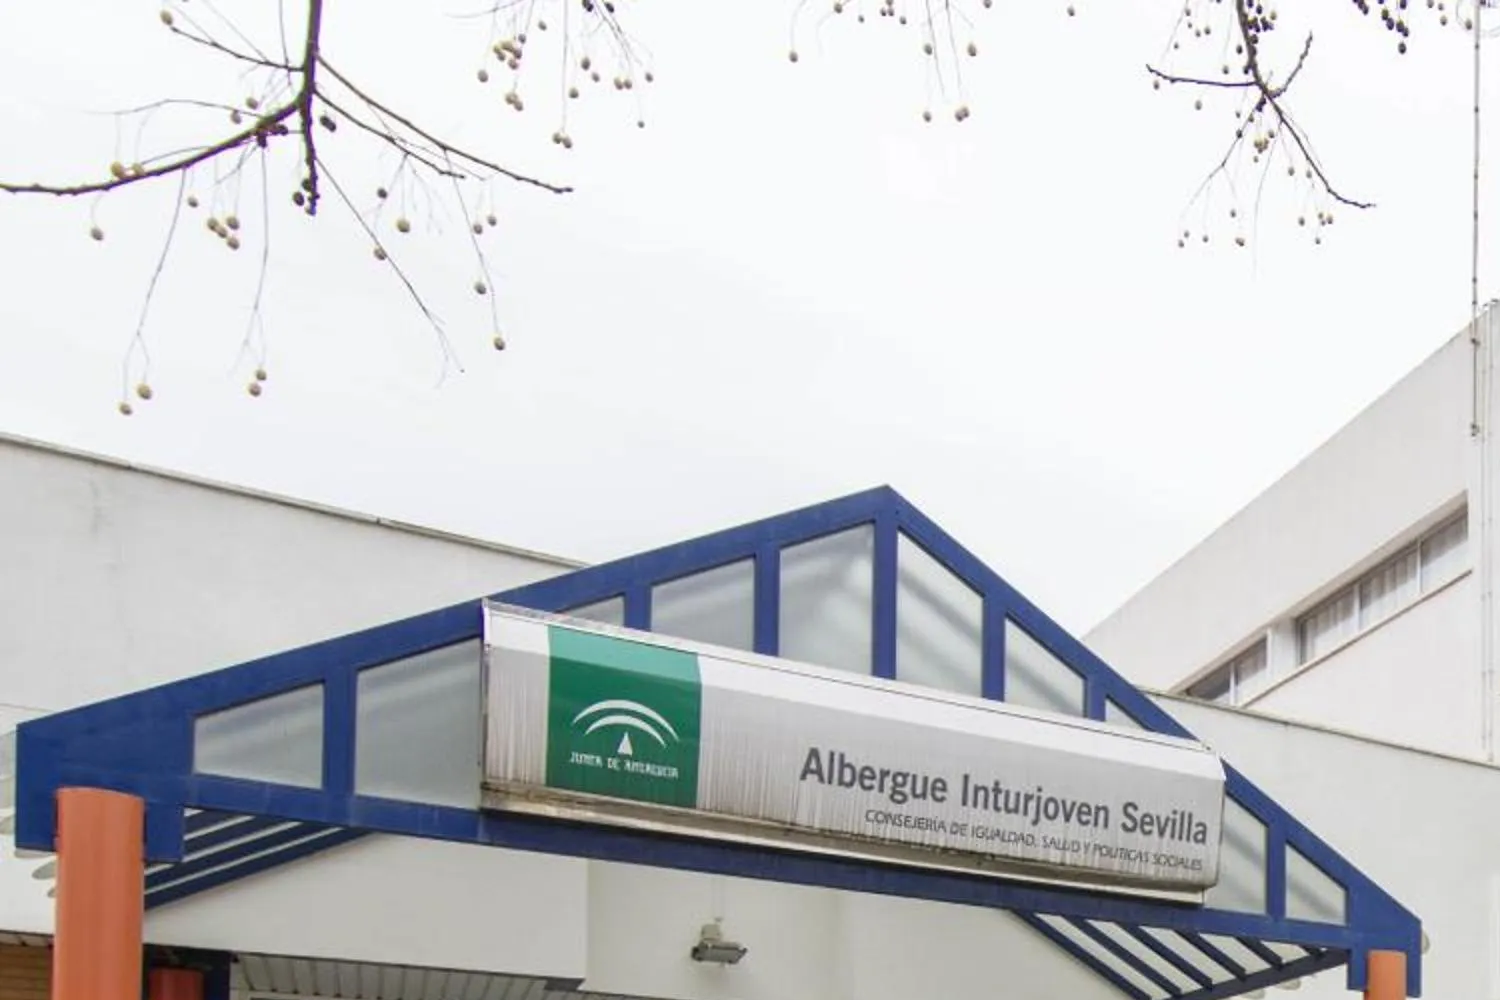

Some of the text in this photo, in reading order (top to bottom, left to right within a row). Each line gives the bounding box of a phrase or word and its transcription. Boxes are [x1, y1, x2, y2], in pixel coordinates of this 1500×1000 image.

[800, 747, 1208, 845] Albergue Inturjoven Sevilla
[949, 821, 968, 838] DE
[1152, 853, 1203, 871] SOCIALES
